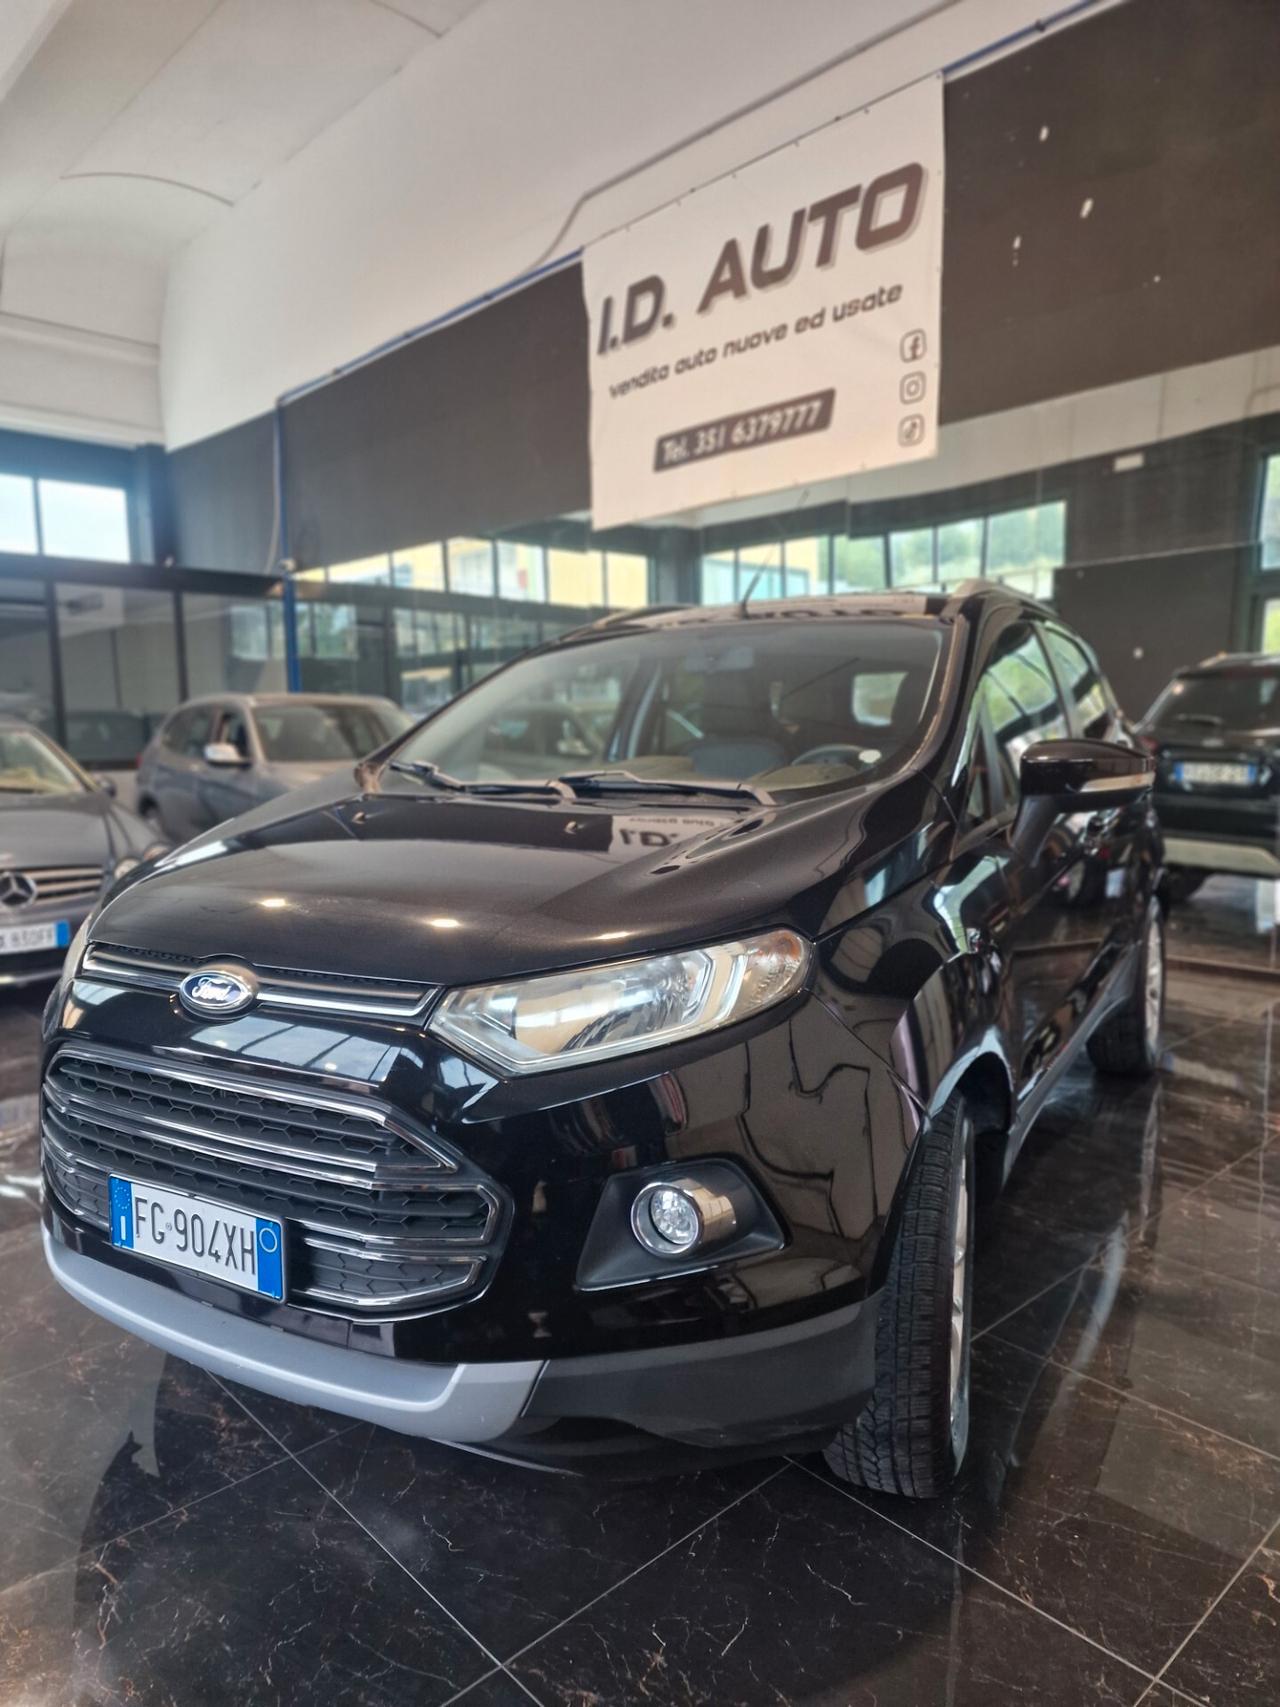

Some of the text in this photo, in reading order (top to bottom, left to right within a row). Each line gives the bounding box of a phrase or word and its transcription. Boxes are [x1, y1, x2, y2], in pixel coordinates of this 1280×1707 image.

[597, 162, 926, 356] I.D. AUTO
[609, 284, 904, 399] vendita auto nuove ed usate
[662, 399, 824, 465] Tel. 351 6379777
